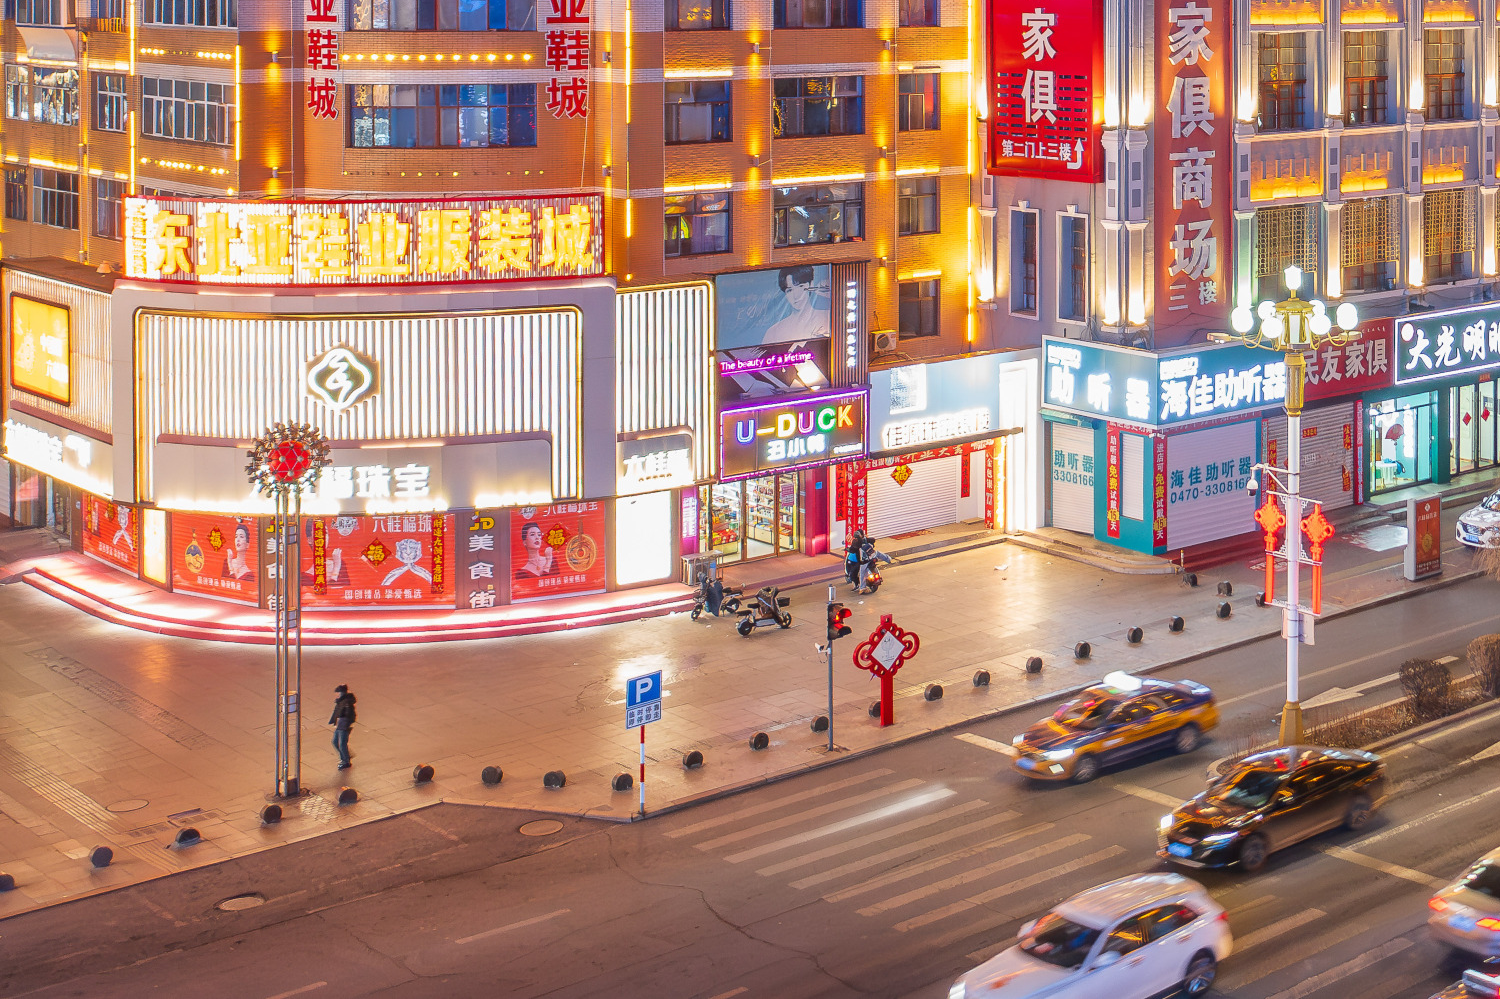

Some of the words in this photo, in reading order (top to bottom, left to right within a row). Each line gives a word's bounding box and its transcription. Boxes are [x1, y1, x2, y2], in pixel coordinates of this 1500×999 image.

[1001, 139, 1072, 163] 第二门上三楼
[153, 204, 594, 277] 东北亚鞋业服装城
[1168, 279, 1217, 312] 三楼
[720, 362, 736, 371] The
[737, 358, 764, 369] beauty
[766, 356, 776, 365] of
[1304, 338, 1388, 386] 民友家俱
[1051, 365, 1150, 420] 助听器
[1160, 362, 1286, 420] 海佳助听器
[736, 405, 853, 443] U-DUCK
[1054, 449, 1094, 472] 助听器
[1170, 456, 1251, 489] 海佳助听器
[250, 464, 430, 499] 福珠宝
[1053, 470, 1094, 487] 3308166
[372, 514, 448, 533] 六桂福珠
[548, 528, 565, 546] 福
[468, 534, 496, 609] 美食街
[635, 677, 653, 703] P
